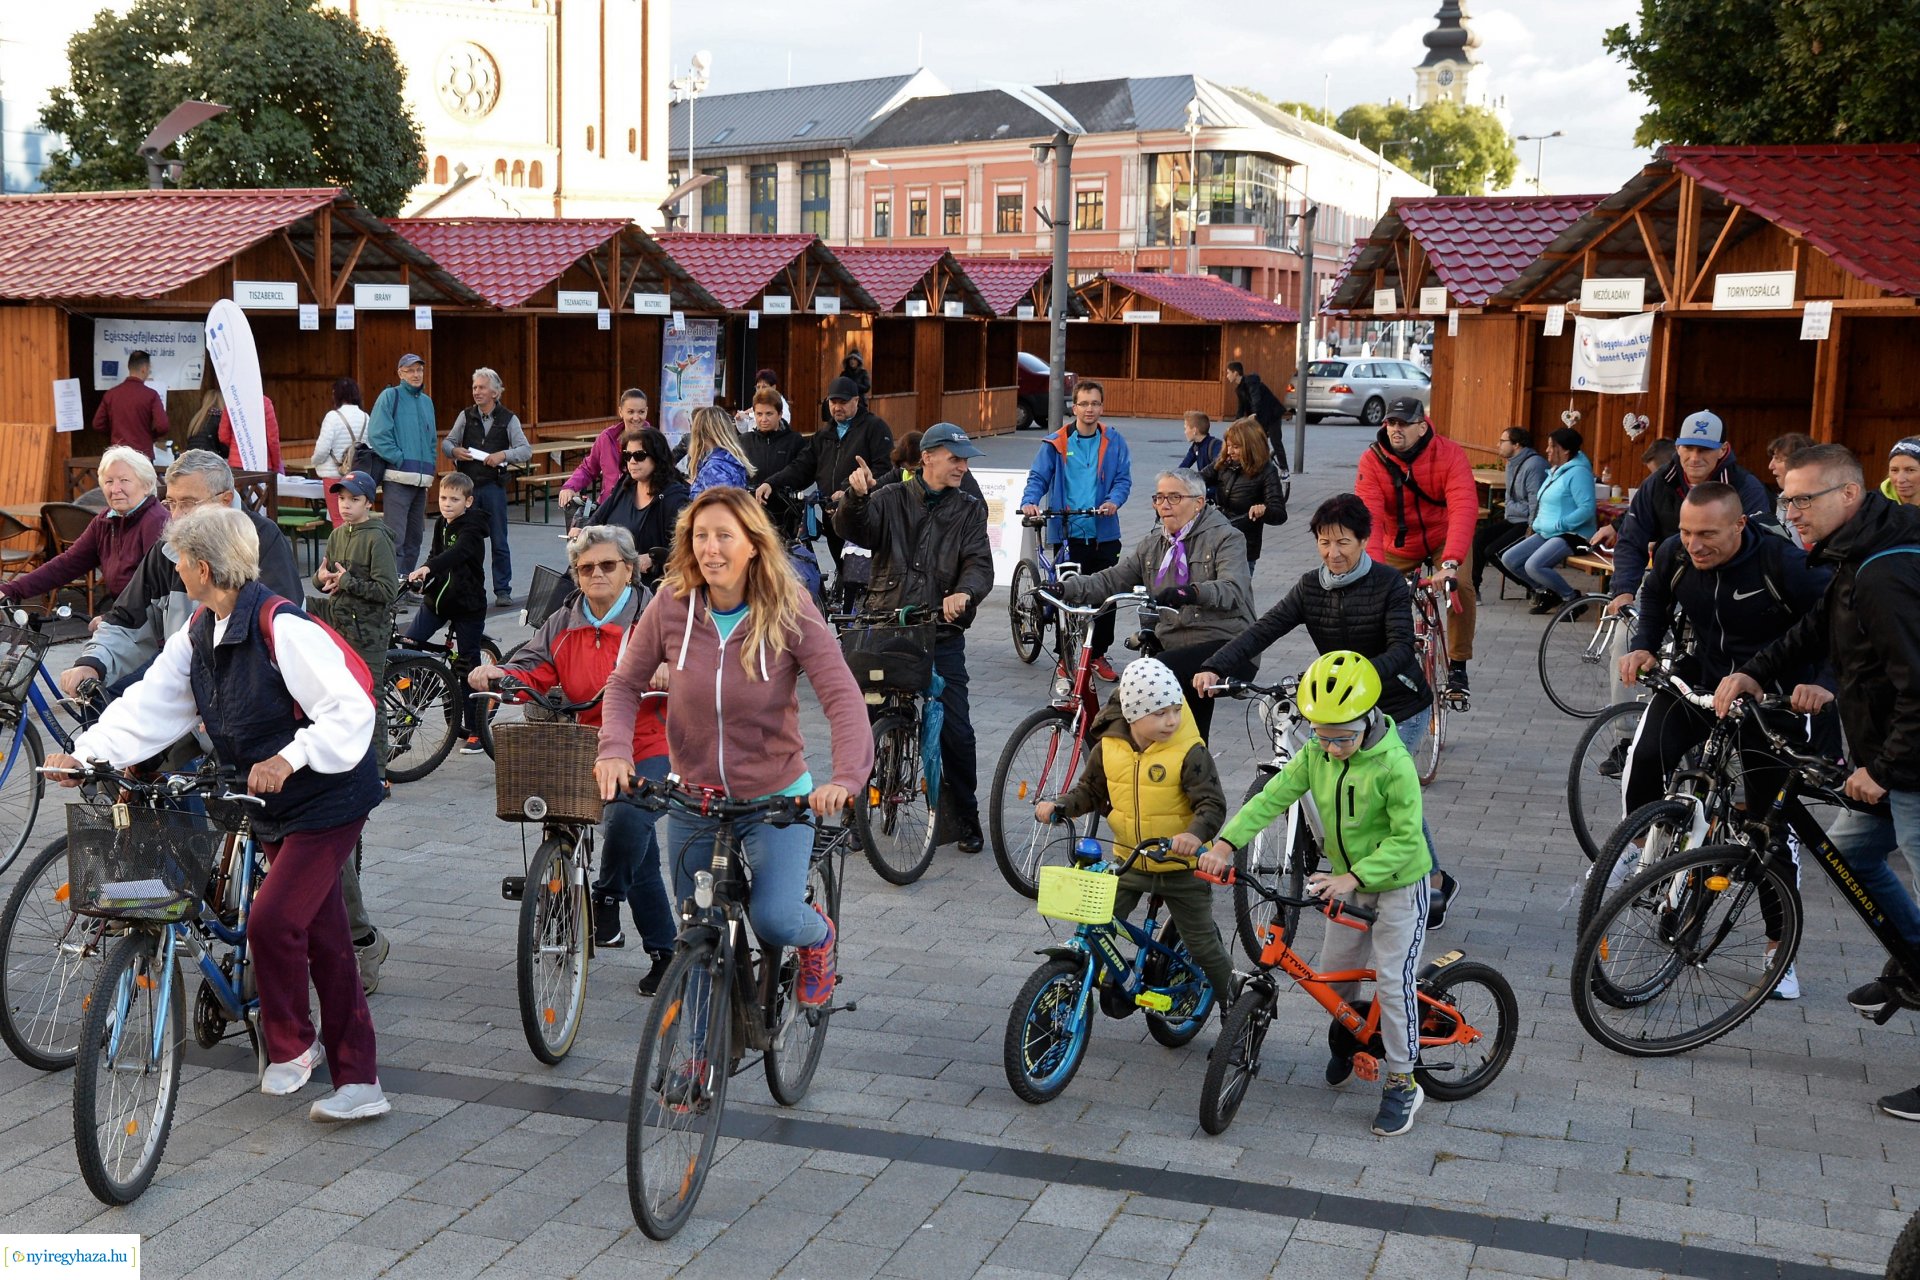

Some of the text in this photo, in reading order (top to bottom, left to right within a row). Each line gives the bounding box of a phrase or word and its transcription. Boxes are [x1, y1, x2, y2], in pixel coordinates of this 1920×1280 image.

[249, 291, 284, 300] TISZABERCEL
[1593, 288, 1630, 300] MEZŐLADÁNY
[1727, 283, 1780, 297] TORNYOSPÁLCA
[374, 292, 392, 301] IBRÁNY
[103, 329, 197, 344] Egészségfejlesztési Iroda
[160, 348, 175, 356] Járás
[1098, 937, 1125, 972] ULTRA
